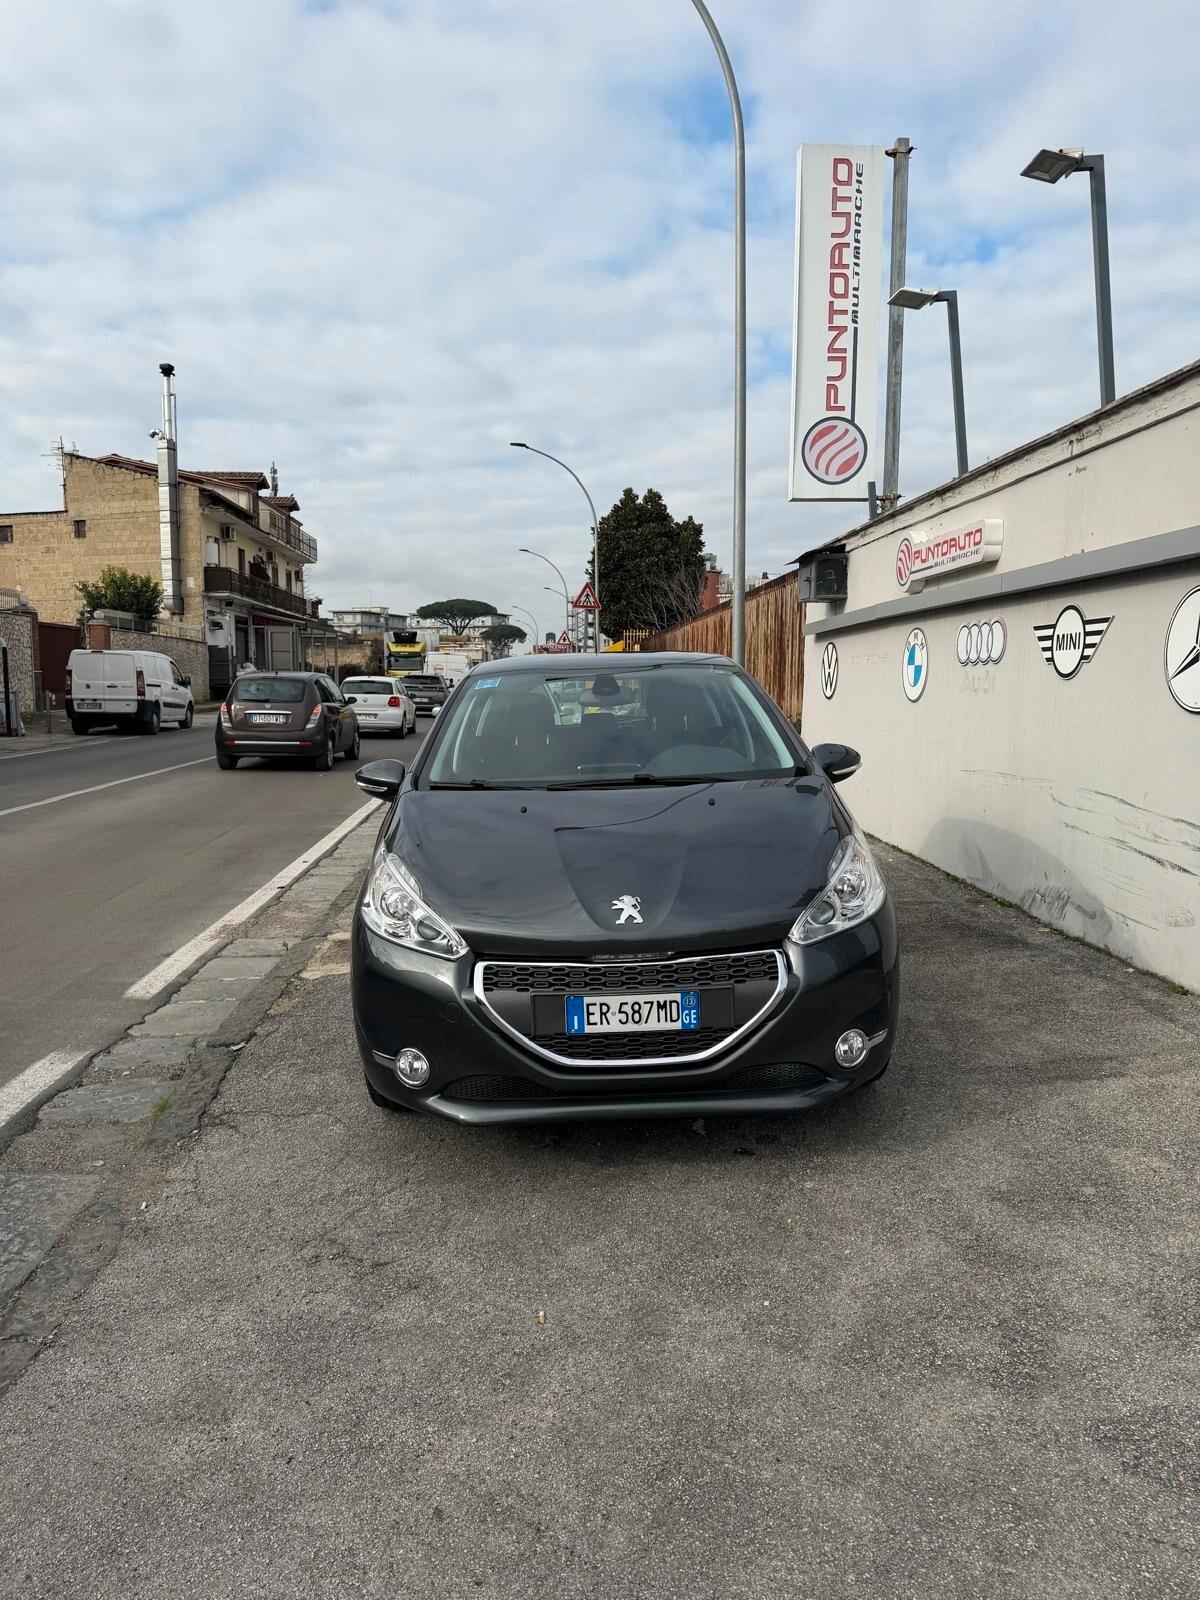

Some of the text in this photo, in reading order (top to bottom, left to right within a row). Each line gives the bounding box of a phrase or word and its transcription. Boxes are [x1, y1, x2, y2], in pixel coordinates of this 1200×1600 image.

[851, 162, 865, 326] MULTIMARCHE
[826, 157, 854, 412] PUNTOAUTO
[912, 528, 983, 567] PUNTOAUTO
[1055, 632, 1082, 651] MINI
[682, 1009, 697, 1024] GE
